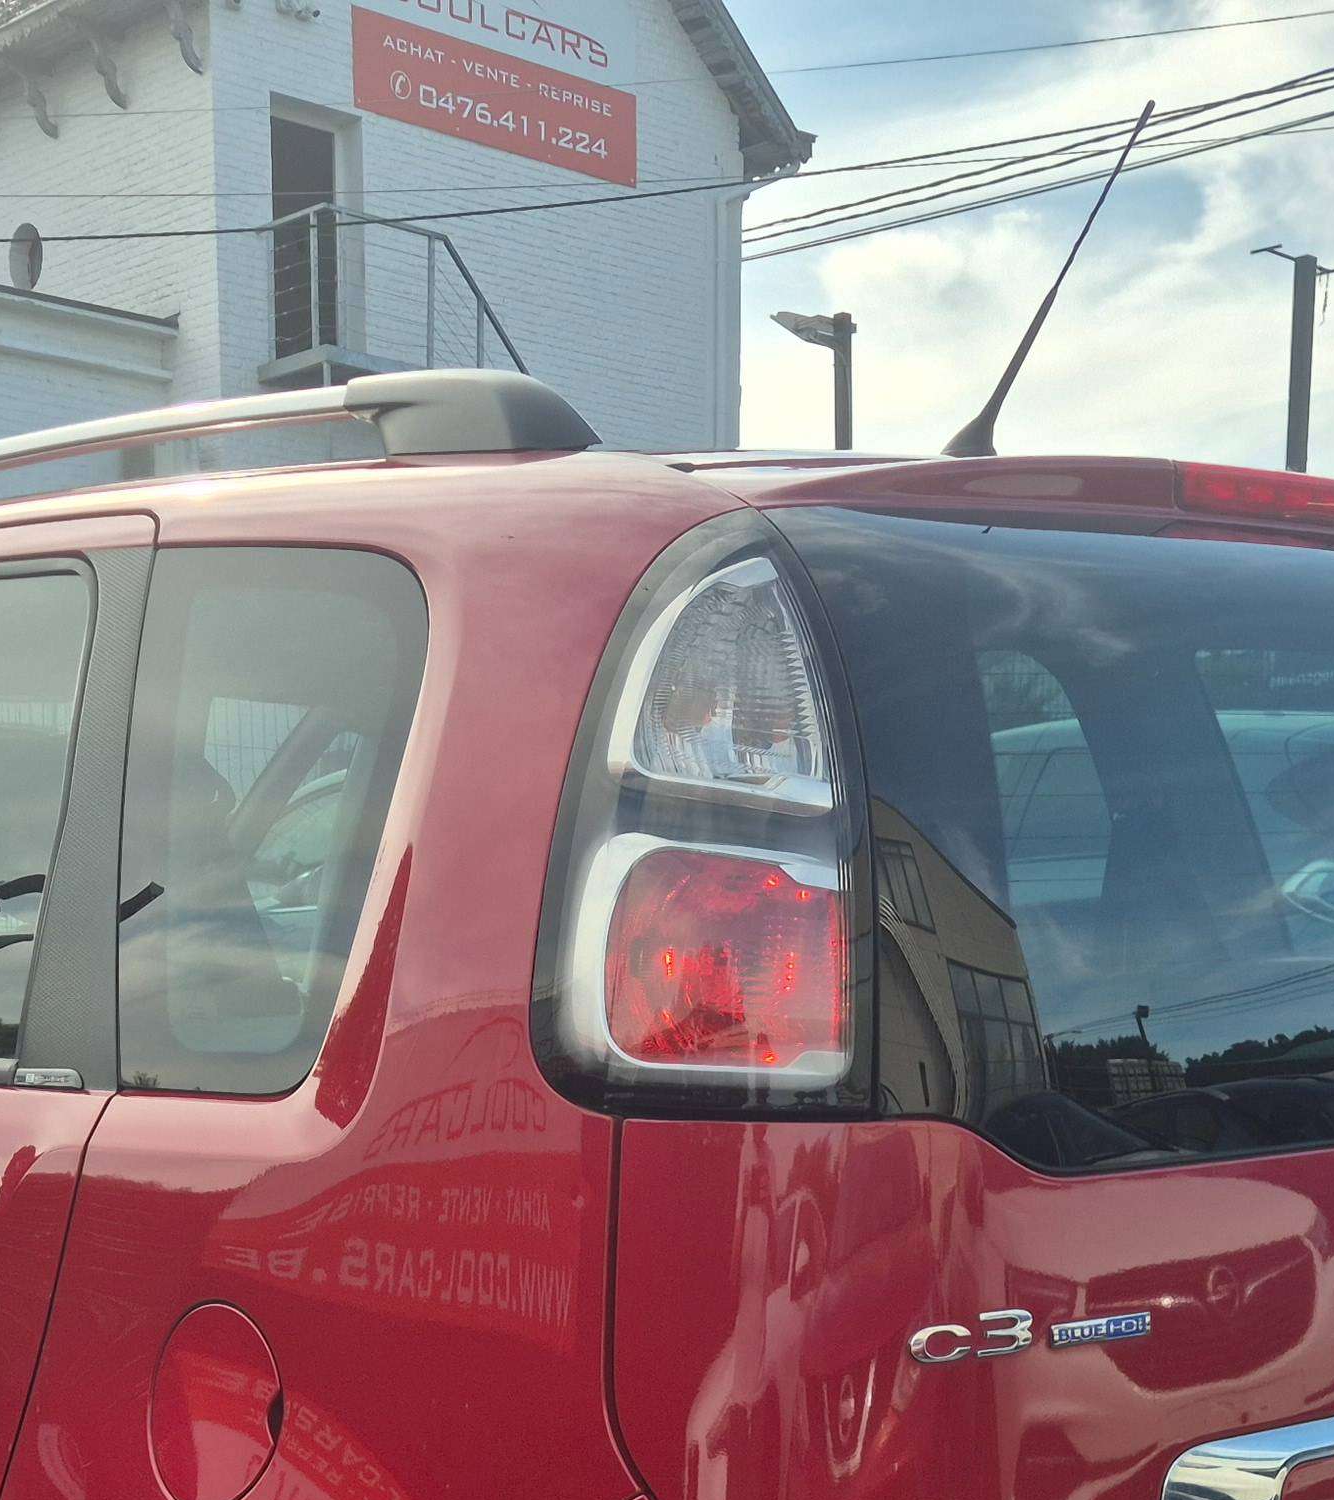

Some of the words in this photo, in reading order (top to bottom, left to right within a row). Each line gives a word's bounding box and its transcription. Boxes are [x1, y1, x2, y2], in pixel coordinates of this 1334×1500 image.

[400, 0, 608, 68] OLCARS
[383, 33, 445, 65] ACHAT
[462, 58, 520, 89] VENTE
[539, 82, 613, 118] REPRISE
[419, 84, 608, 160] 0476.411.224
[909, 1308, 1034, 1363] C3
